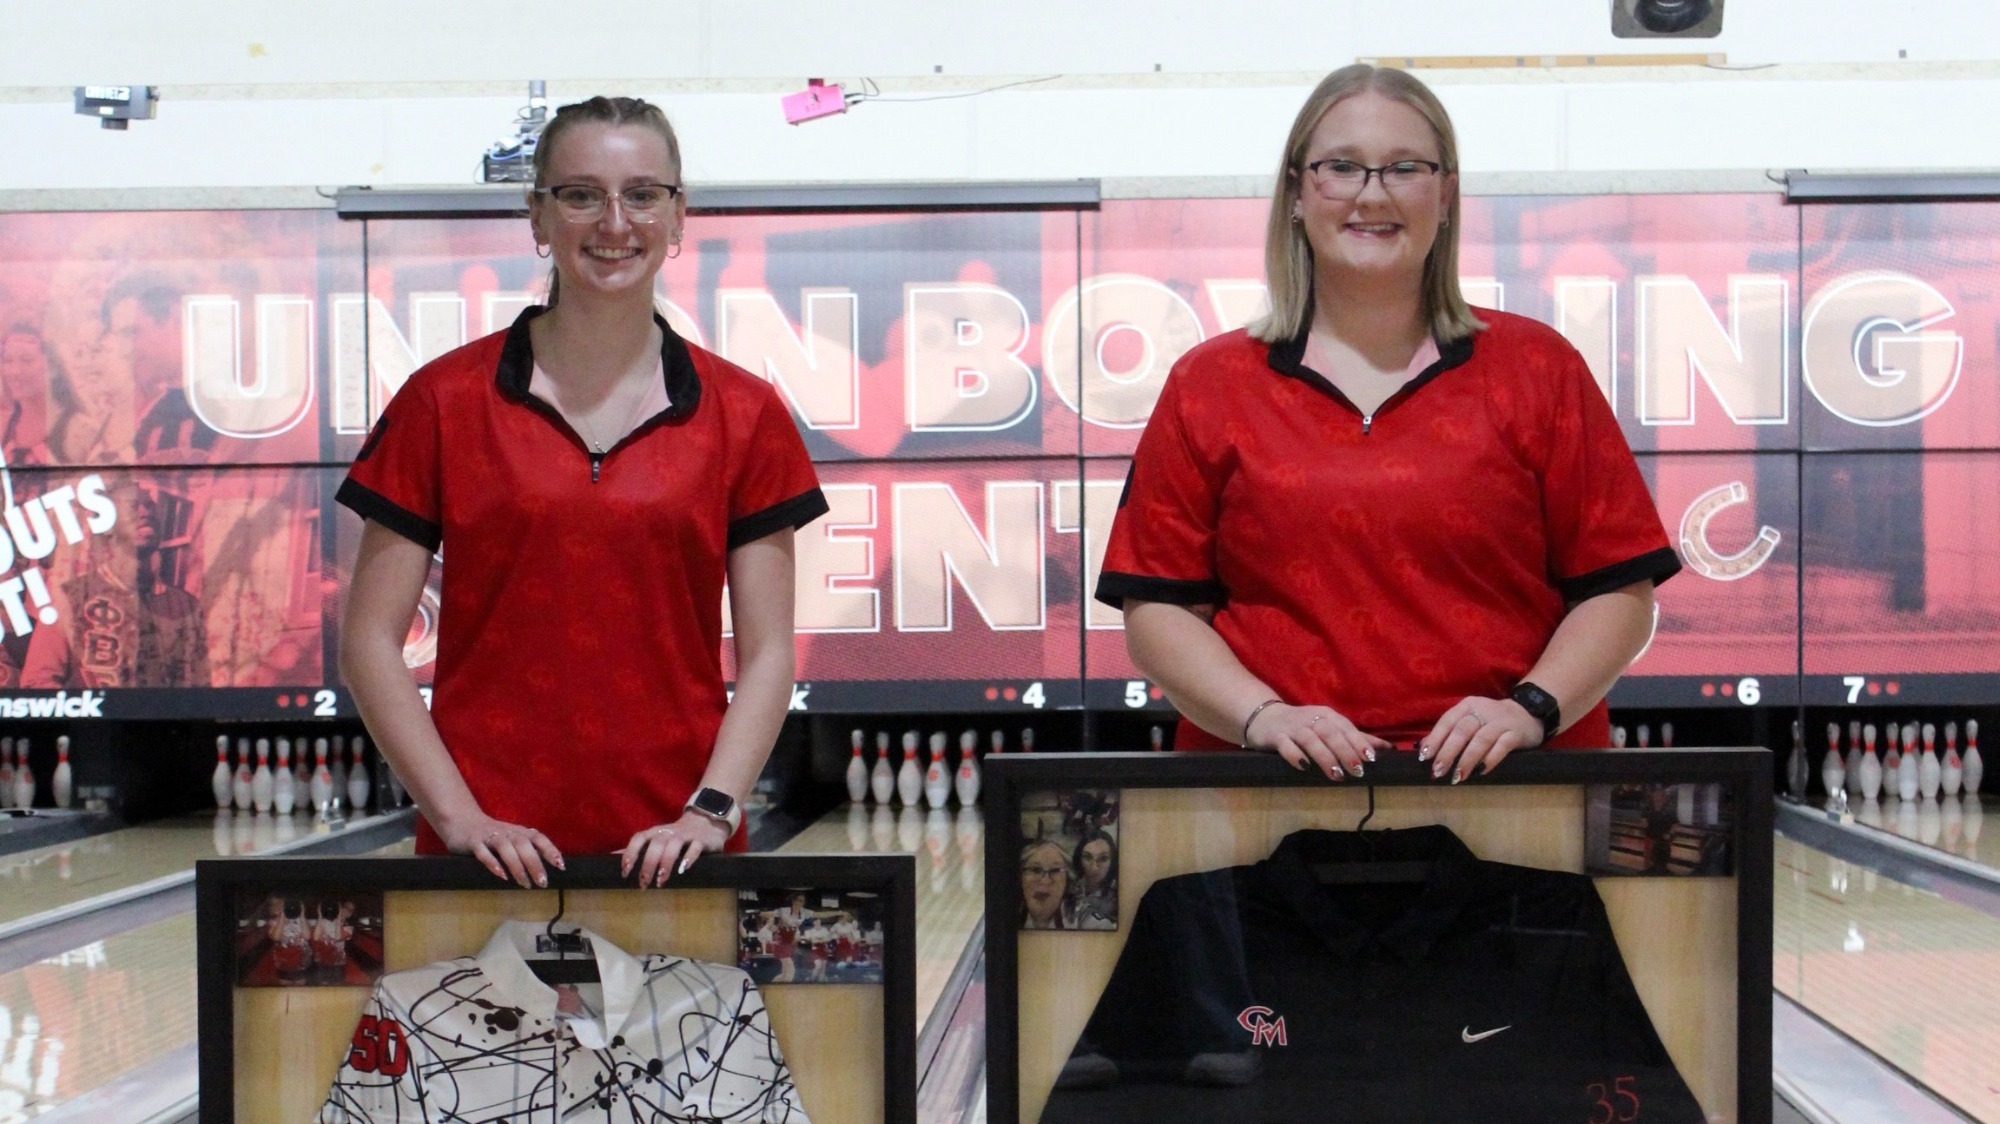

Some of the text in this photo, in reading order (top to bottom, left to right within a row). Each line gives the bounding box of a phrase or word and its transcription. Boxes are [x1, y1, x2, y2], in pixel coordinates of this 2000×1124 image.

[314, 690, 336, 716] 2
[1022, 682, 1046, 709] 4
[1124, 682, 1146, 708] 5
[1737, 678, 1760, 704] 6
[1843, 677, 1865, 703] 7
[1236, 1005, 1288, 1049] CM
[349, 1013, 409, 1078] 50
[1586, 1075, 1640, 1124] 35
